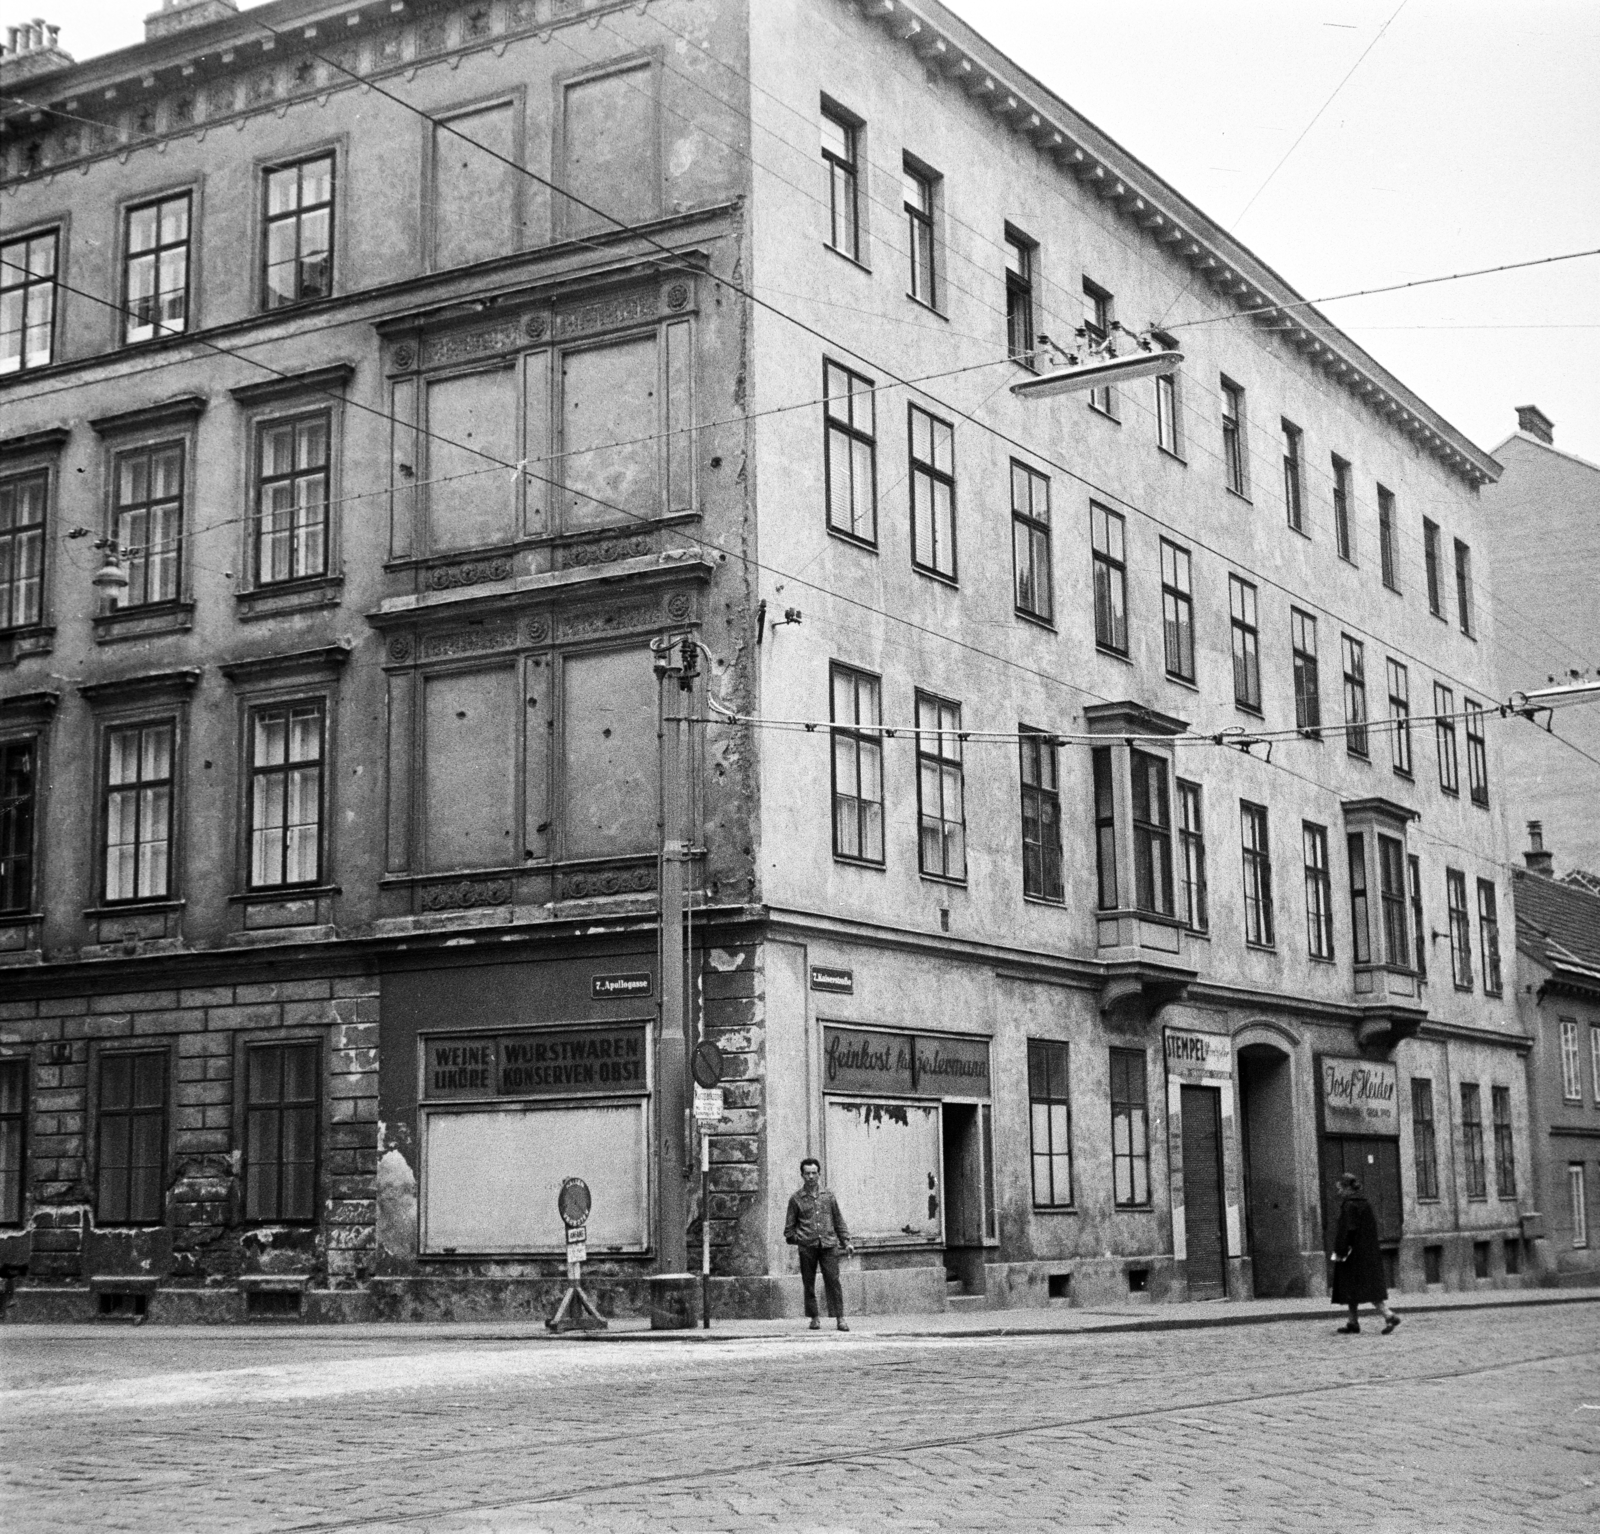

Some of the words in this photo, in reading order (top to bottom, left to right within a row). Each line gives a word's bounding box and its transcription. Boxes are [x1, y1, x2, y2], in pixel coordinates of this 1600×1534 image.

[435, 1046, 490, 1067] WEINE
[504, 1038, 639, 1063] WURSTWAREN
[1166, 1034, 1206, 1061] STEMPEL
[434, 1067, 489, 1090] LIKÖRE
[916, 1049, 987, 1082] jedermann
[1325, 1066, 1356, 1105] Josef
[1355, 1068, 1395, 1101] Heider
